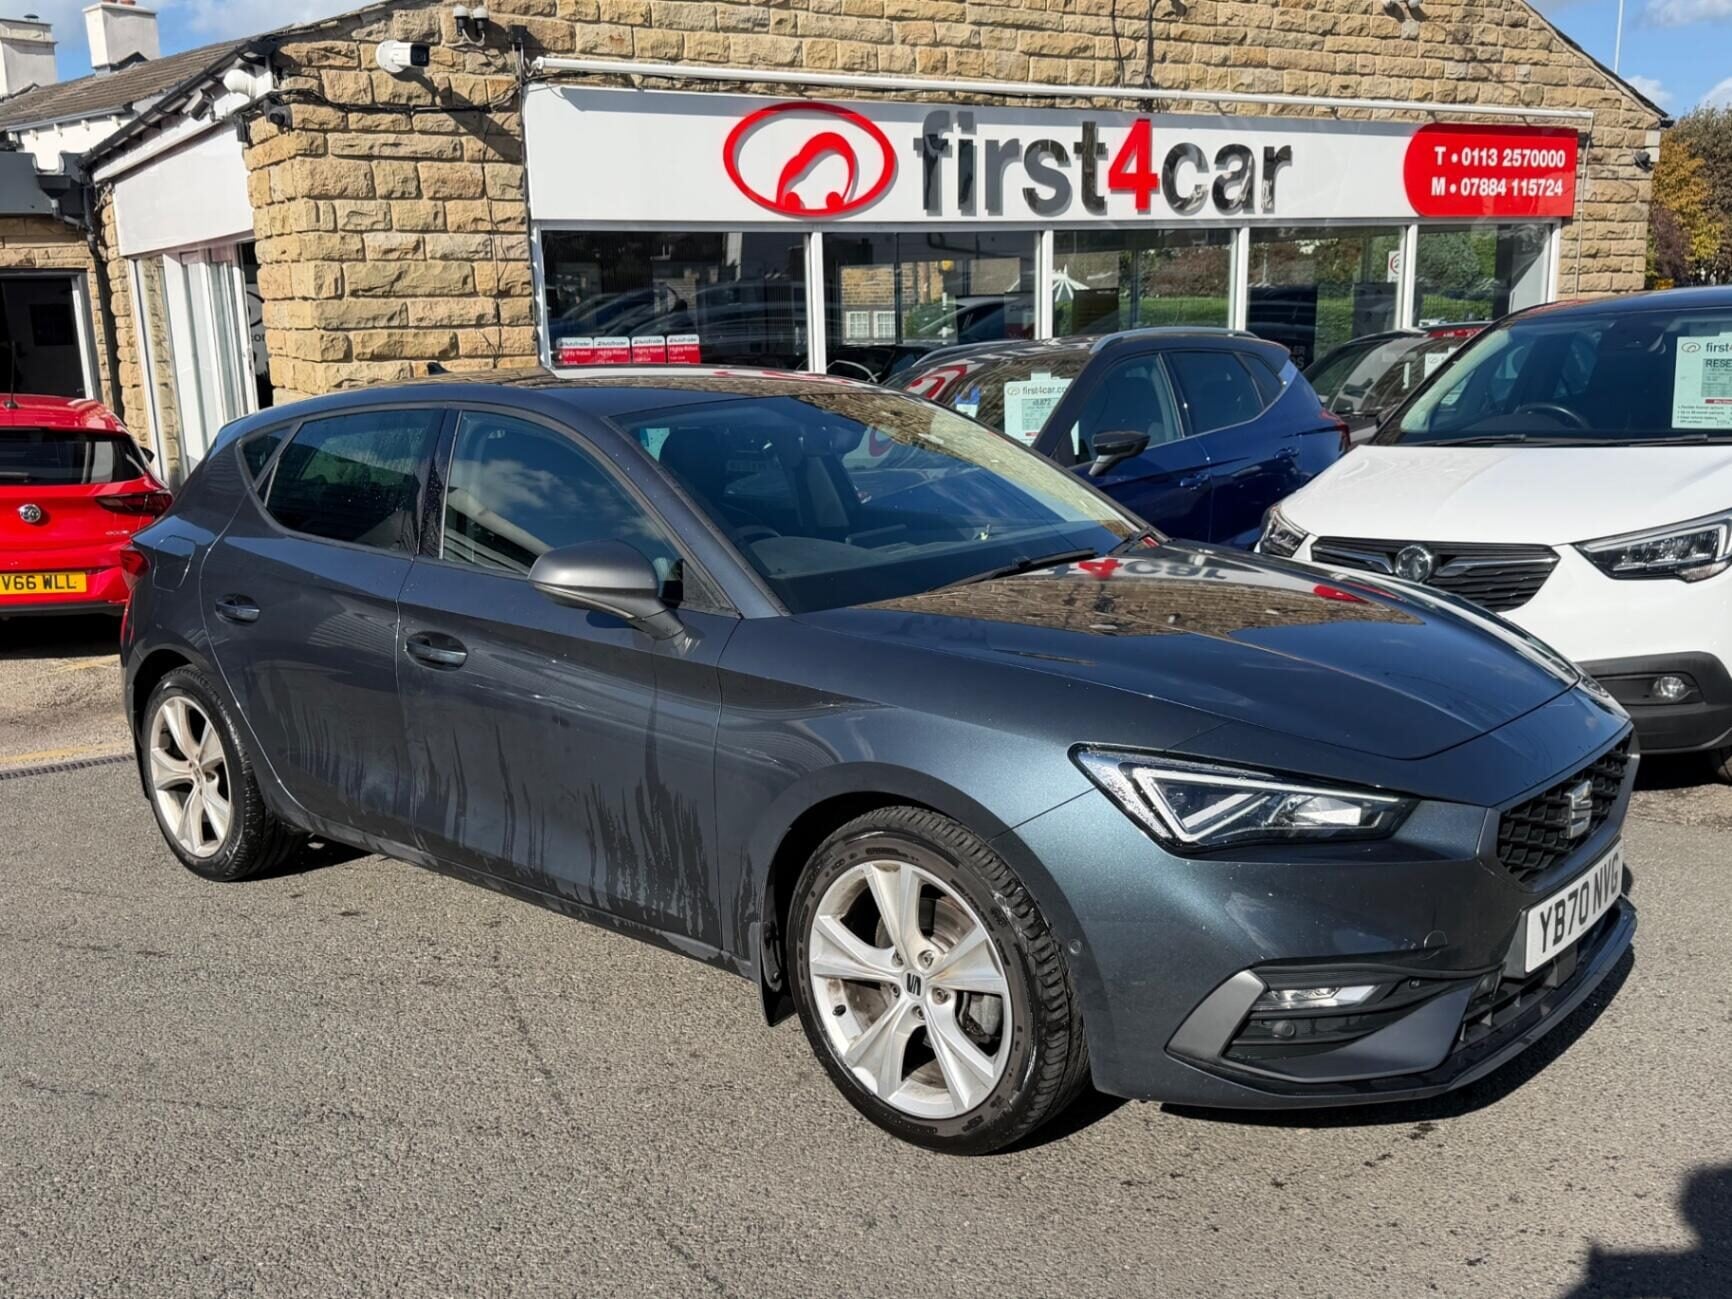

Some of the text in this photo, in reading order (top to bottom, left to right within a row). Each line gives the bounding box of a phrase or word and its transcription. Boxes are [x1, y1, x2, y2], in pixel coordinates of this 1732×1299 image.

[913, 110, 1292, 217] first4car
[1434, 146, 1566, 168] T 0113 2570000
[1430, 176, 1563, 197] M 07884 115724
[42, 573, 77, 590] WLL
[1540, 853, 1620, 954] YB70 NVG
